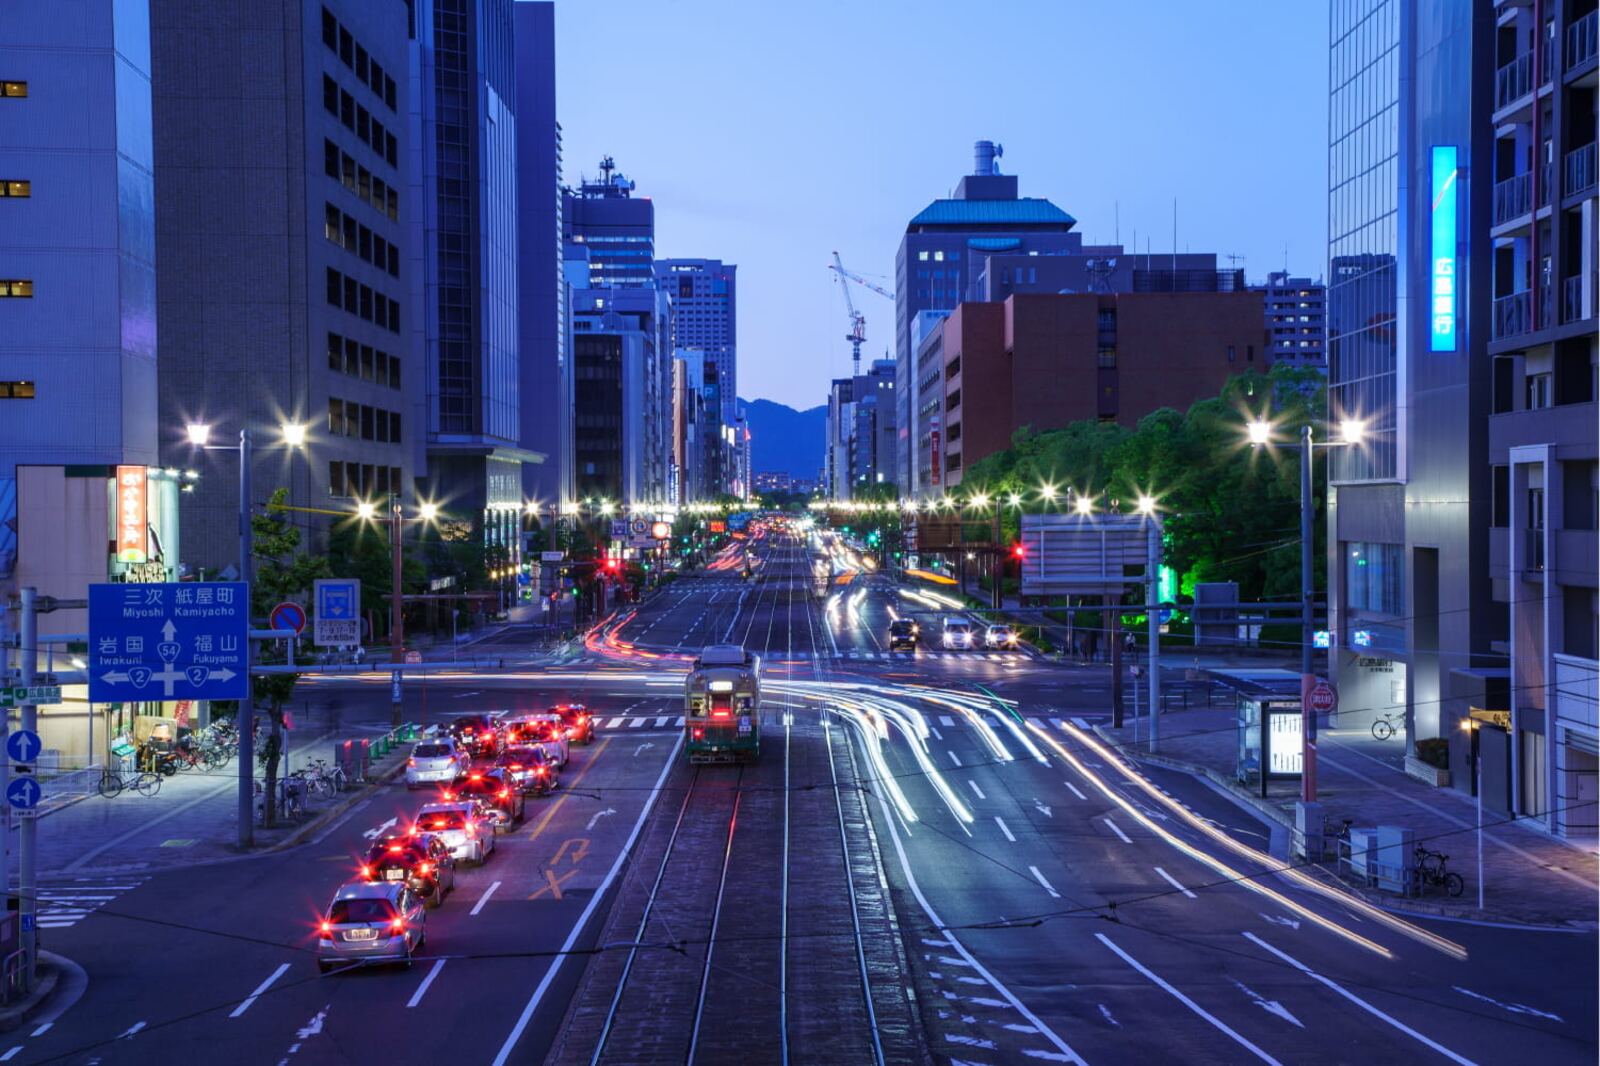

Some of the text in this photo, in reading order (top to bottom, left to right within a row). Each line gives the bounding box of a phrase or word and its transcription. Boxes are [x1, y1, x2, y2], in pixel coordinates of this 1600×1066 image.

[124, 587, 234, 605] 三次 紙屋町
[123, 607, 235, 619] Miyoshi Kamiyacho
[99, 634, 237, 653] 岩国 福山
[162, 645, 176, 656] 54
[100, 654, 238, 665] Iwakuni Fukuyama
[135, 669, 202, 683] 2 2
